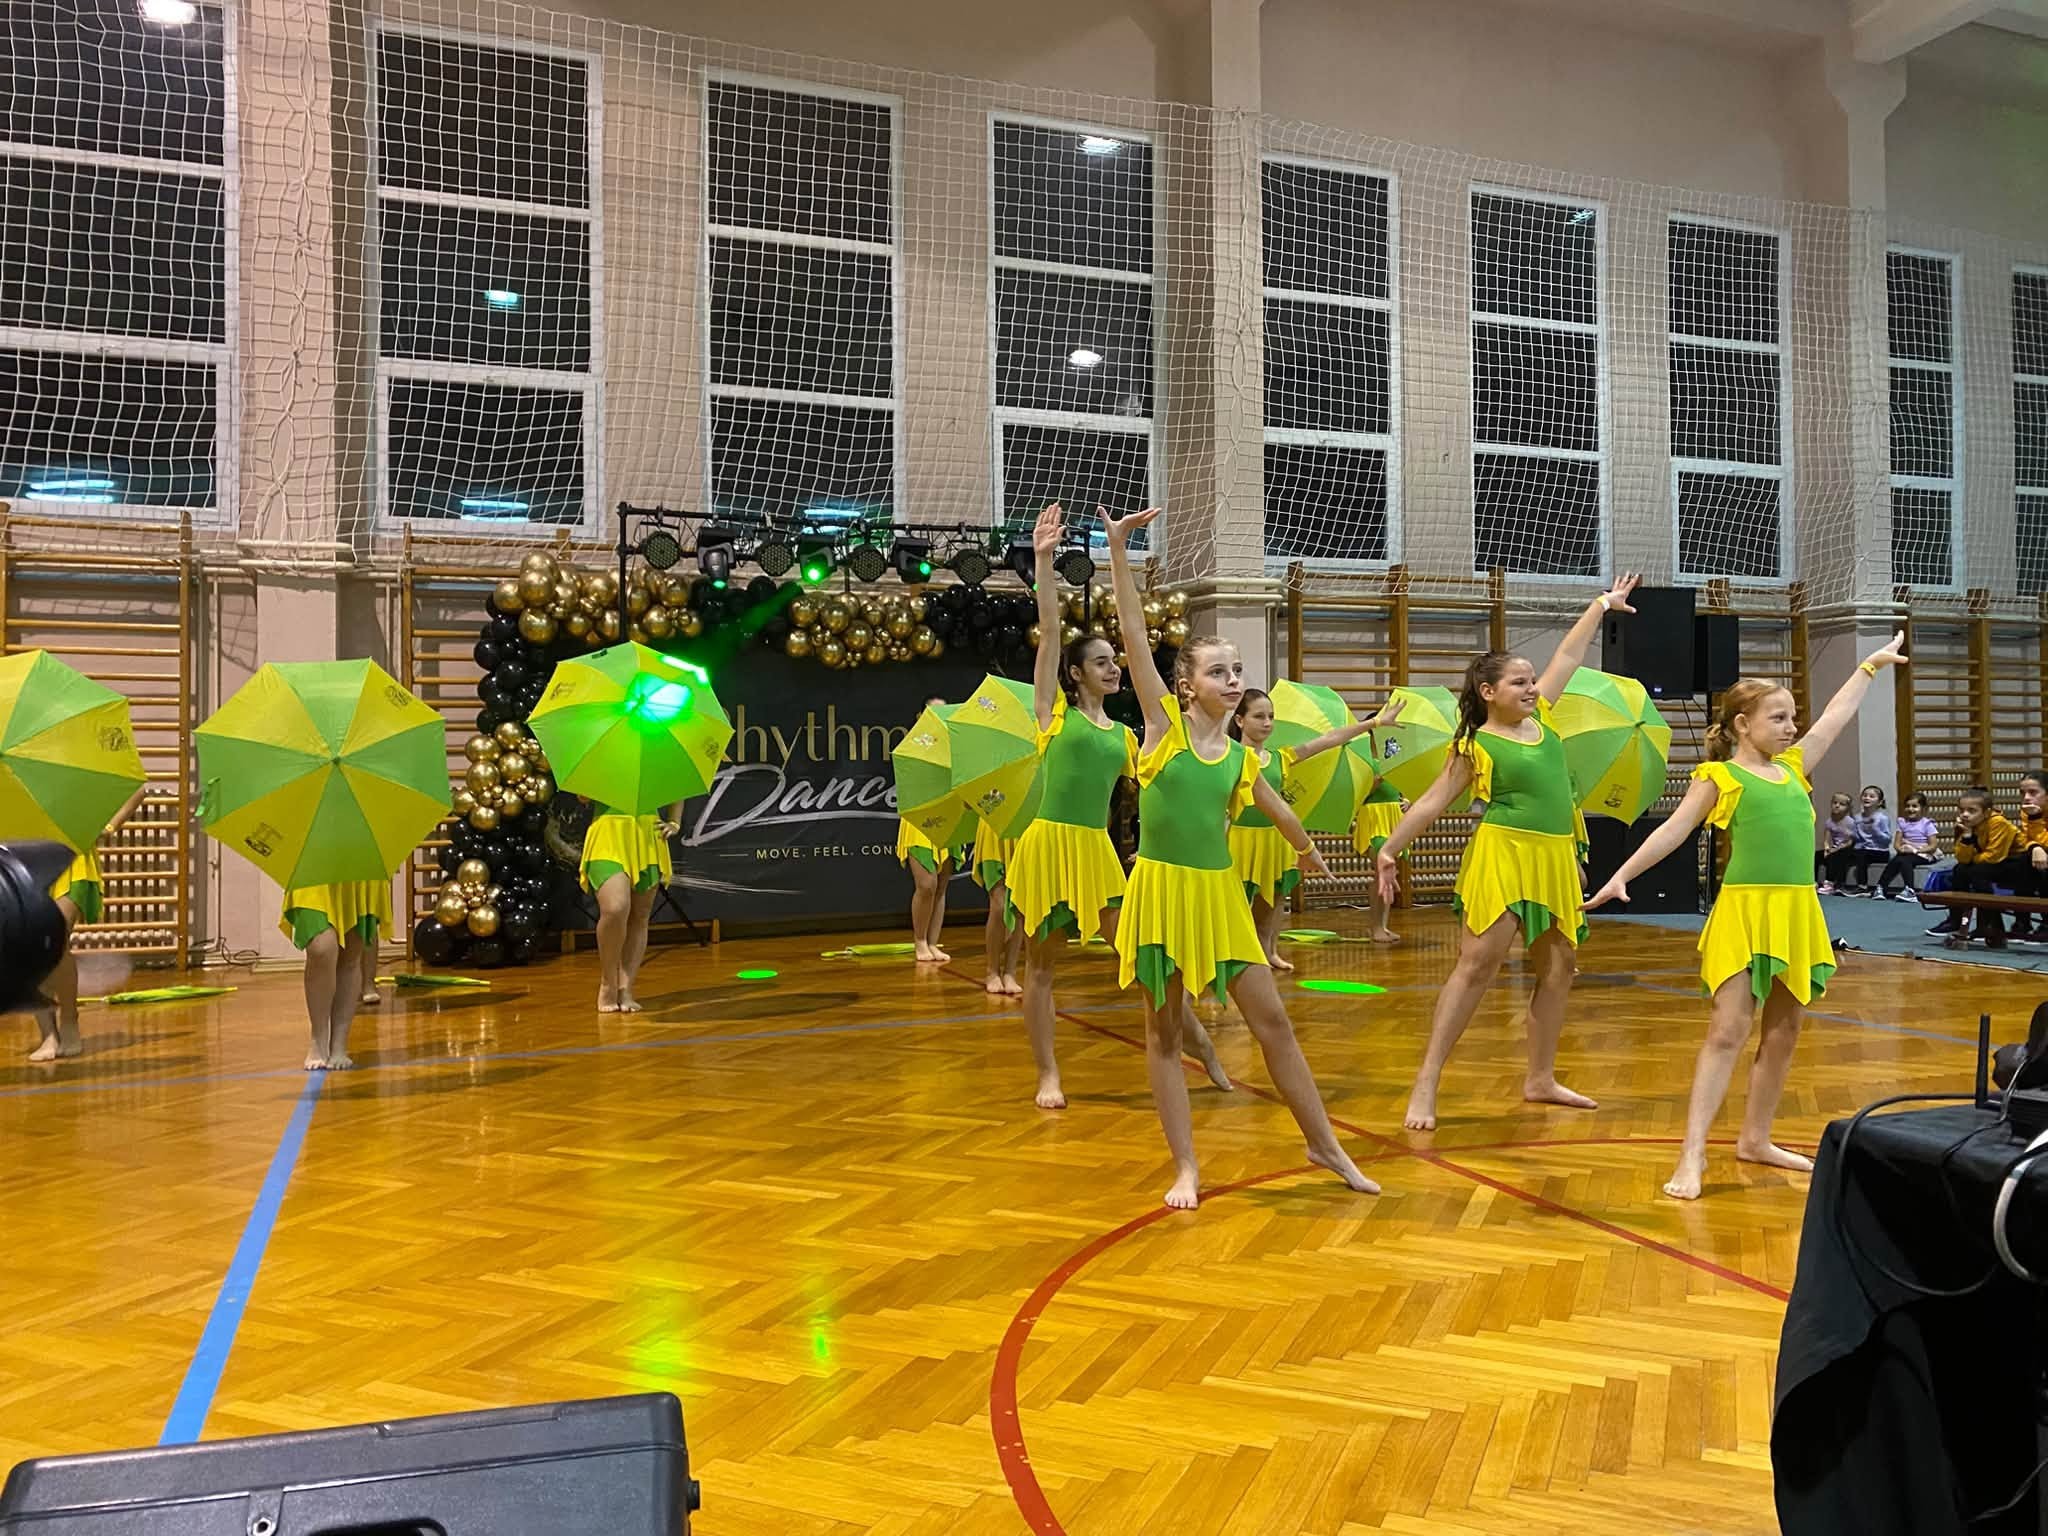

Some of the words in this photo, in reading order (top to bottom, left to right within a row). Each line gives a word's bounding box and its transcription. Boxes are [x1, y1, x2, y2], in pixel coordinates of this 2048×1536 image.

[723, 704, 909, 773] hythm
[756, 848, 806, 859] MOVE.
[813, 846, 854, 857] FEEL.
[861, 845, 898, 856] CON
